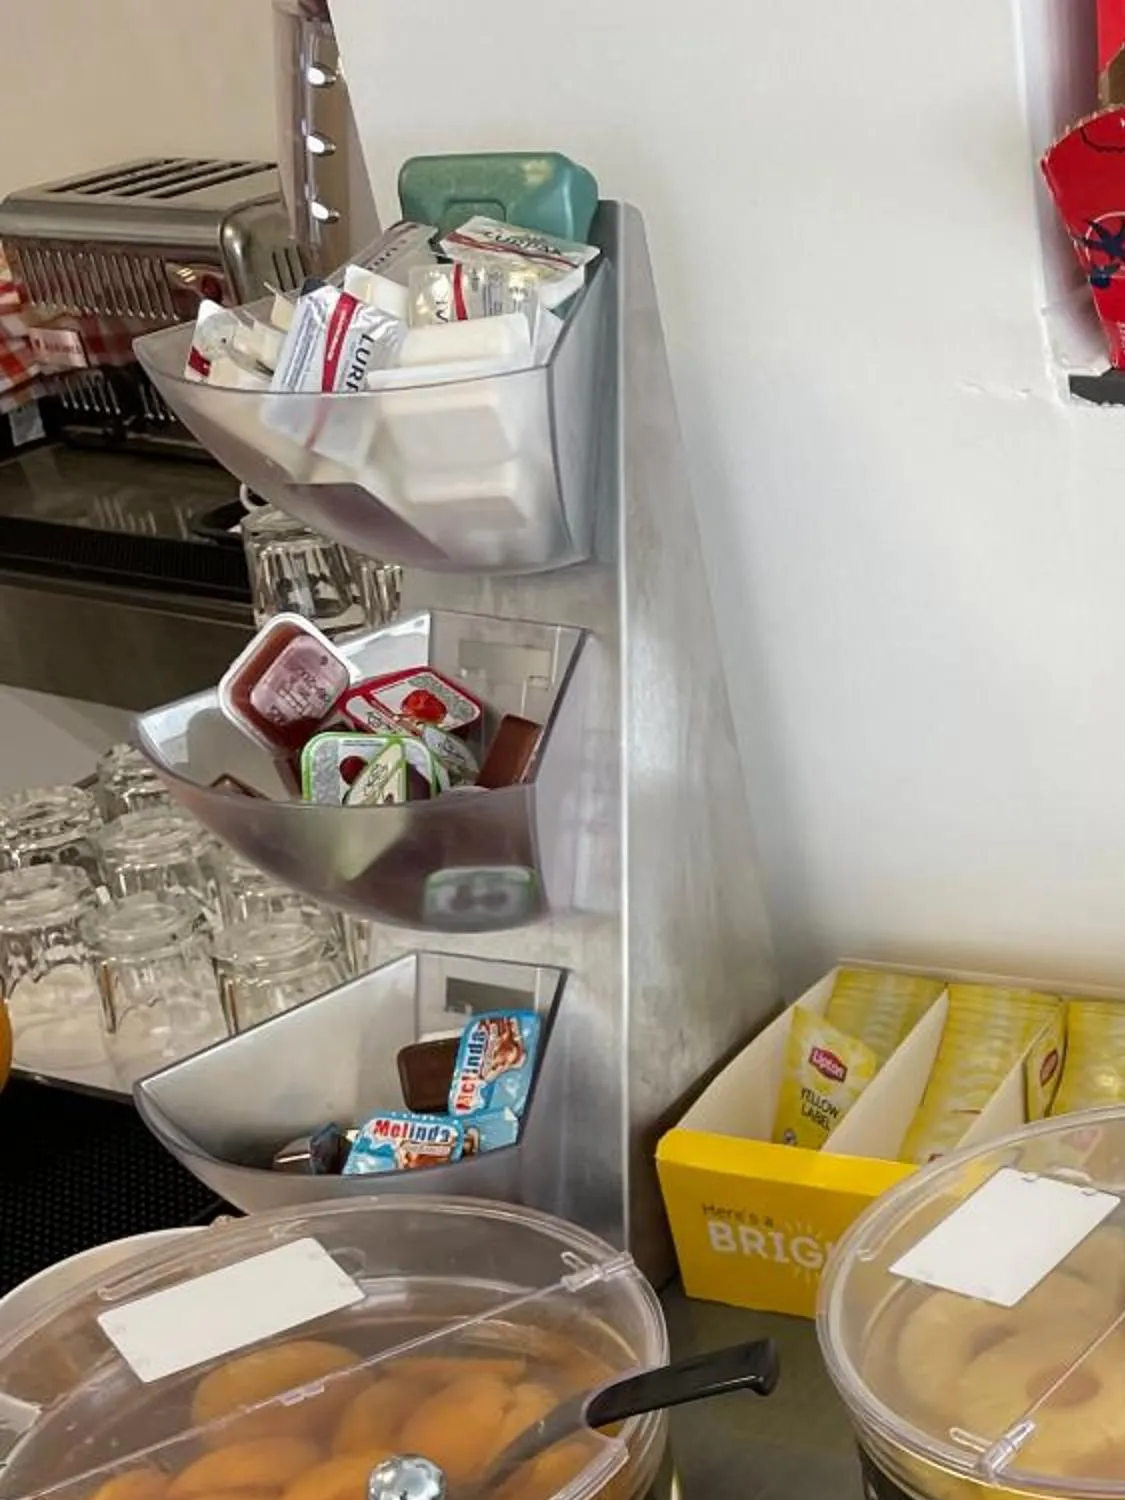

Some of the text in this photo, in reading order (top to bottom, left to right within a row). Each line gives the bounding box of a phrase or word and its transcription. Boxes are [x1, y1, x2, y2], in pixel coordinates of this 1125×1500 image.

[812, 1049, 845, 1080] Lipton
[800, 1087, 840, 1119] YELLOW
[801, 1103, 831, 1131] LABEL
[707, 1220, 838, 1270] BRIG
